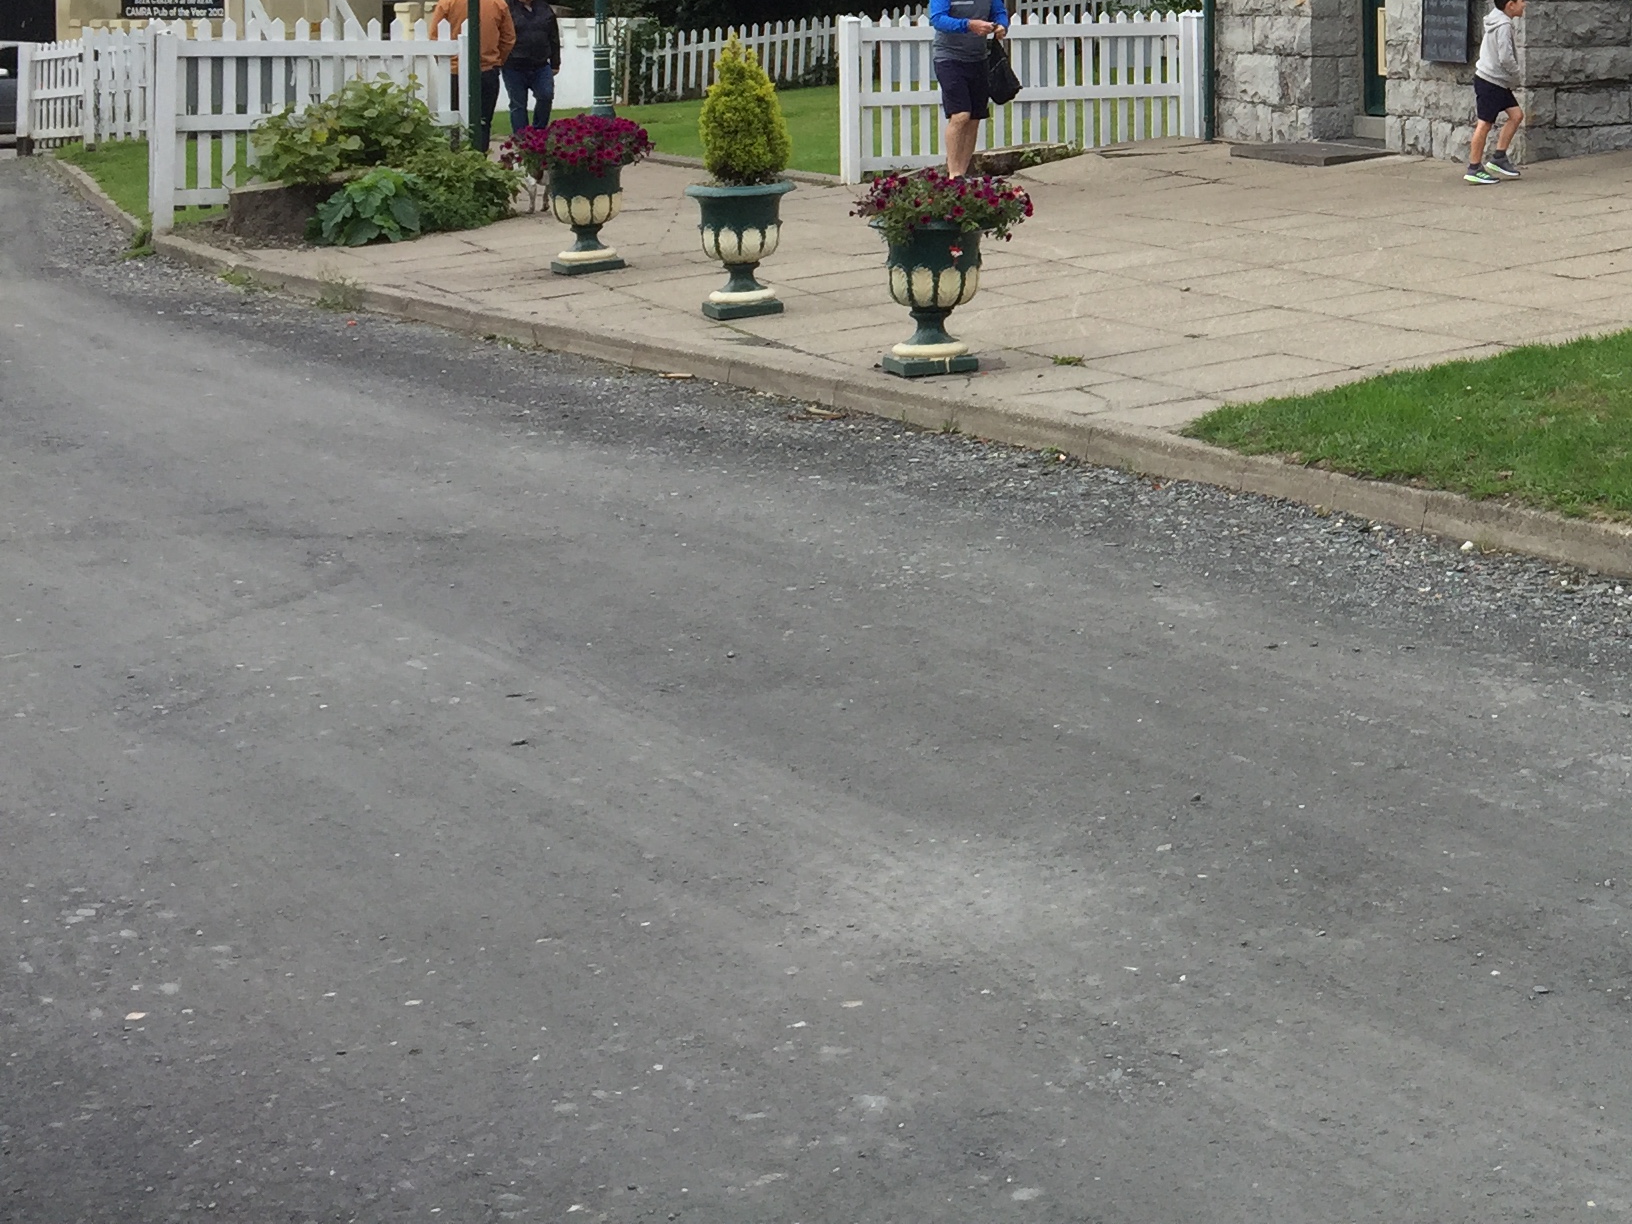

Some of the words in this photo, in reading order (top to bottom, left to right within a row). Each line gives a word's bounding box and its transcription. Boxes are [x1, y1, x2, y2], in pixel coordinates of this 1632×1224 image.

[125, 6, 153, 17] CAMRA
[153, 6, 168, 17] Pub
[169, 6, 177, 17] of
[177, 6, 190, 17] the
[190, 6, 208, 17] Year
